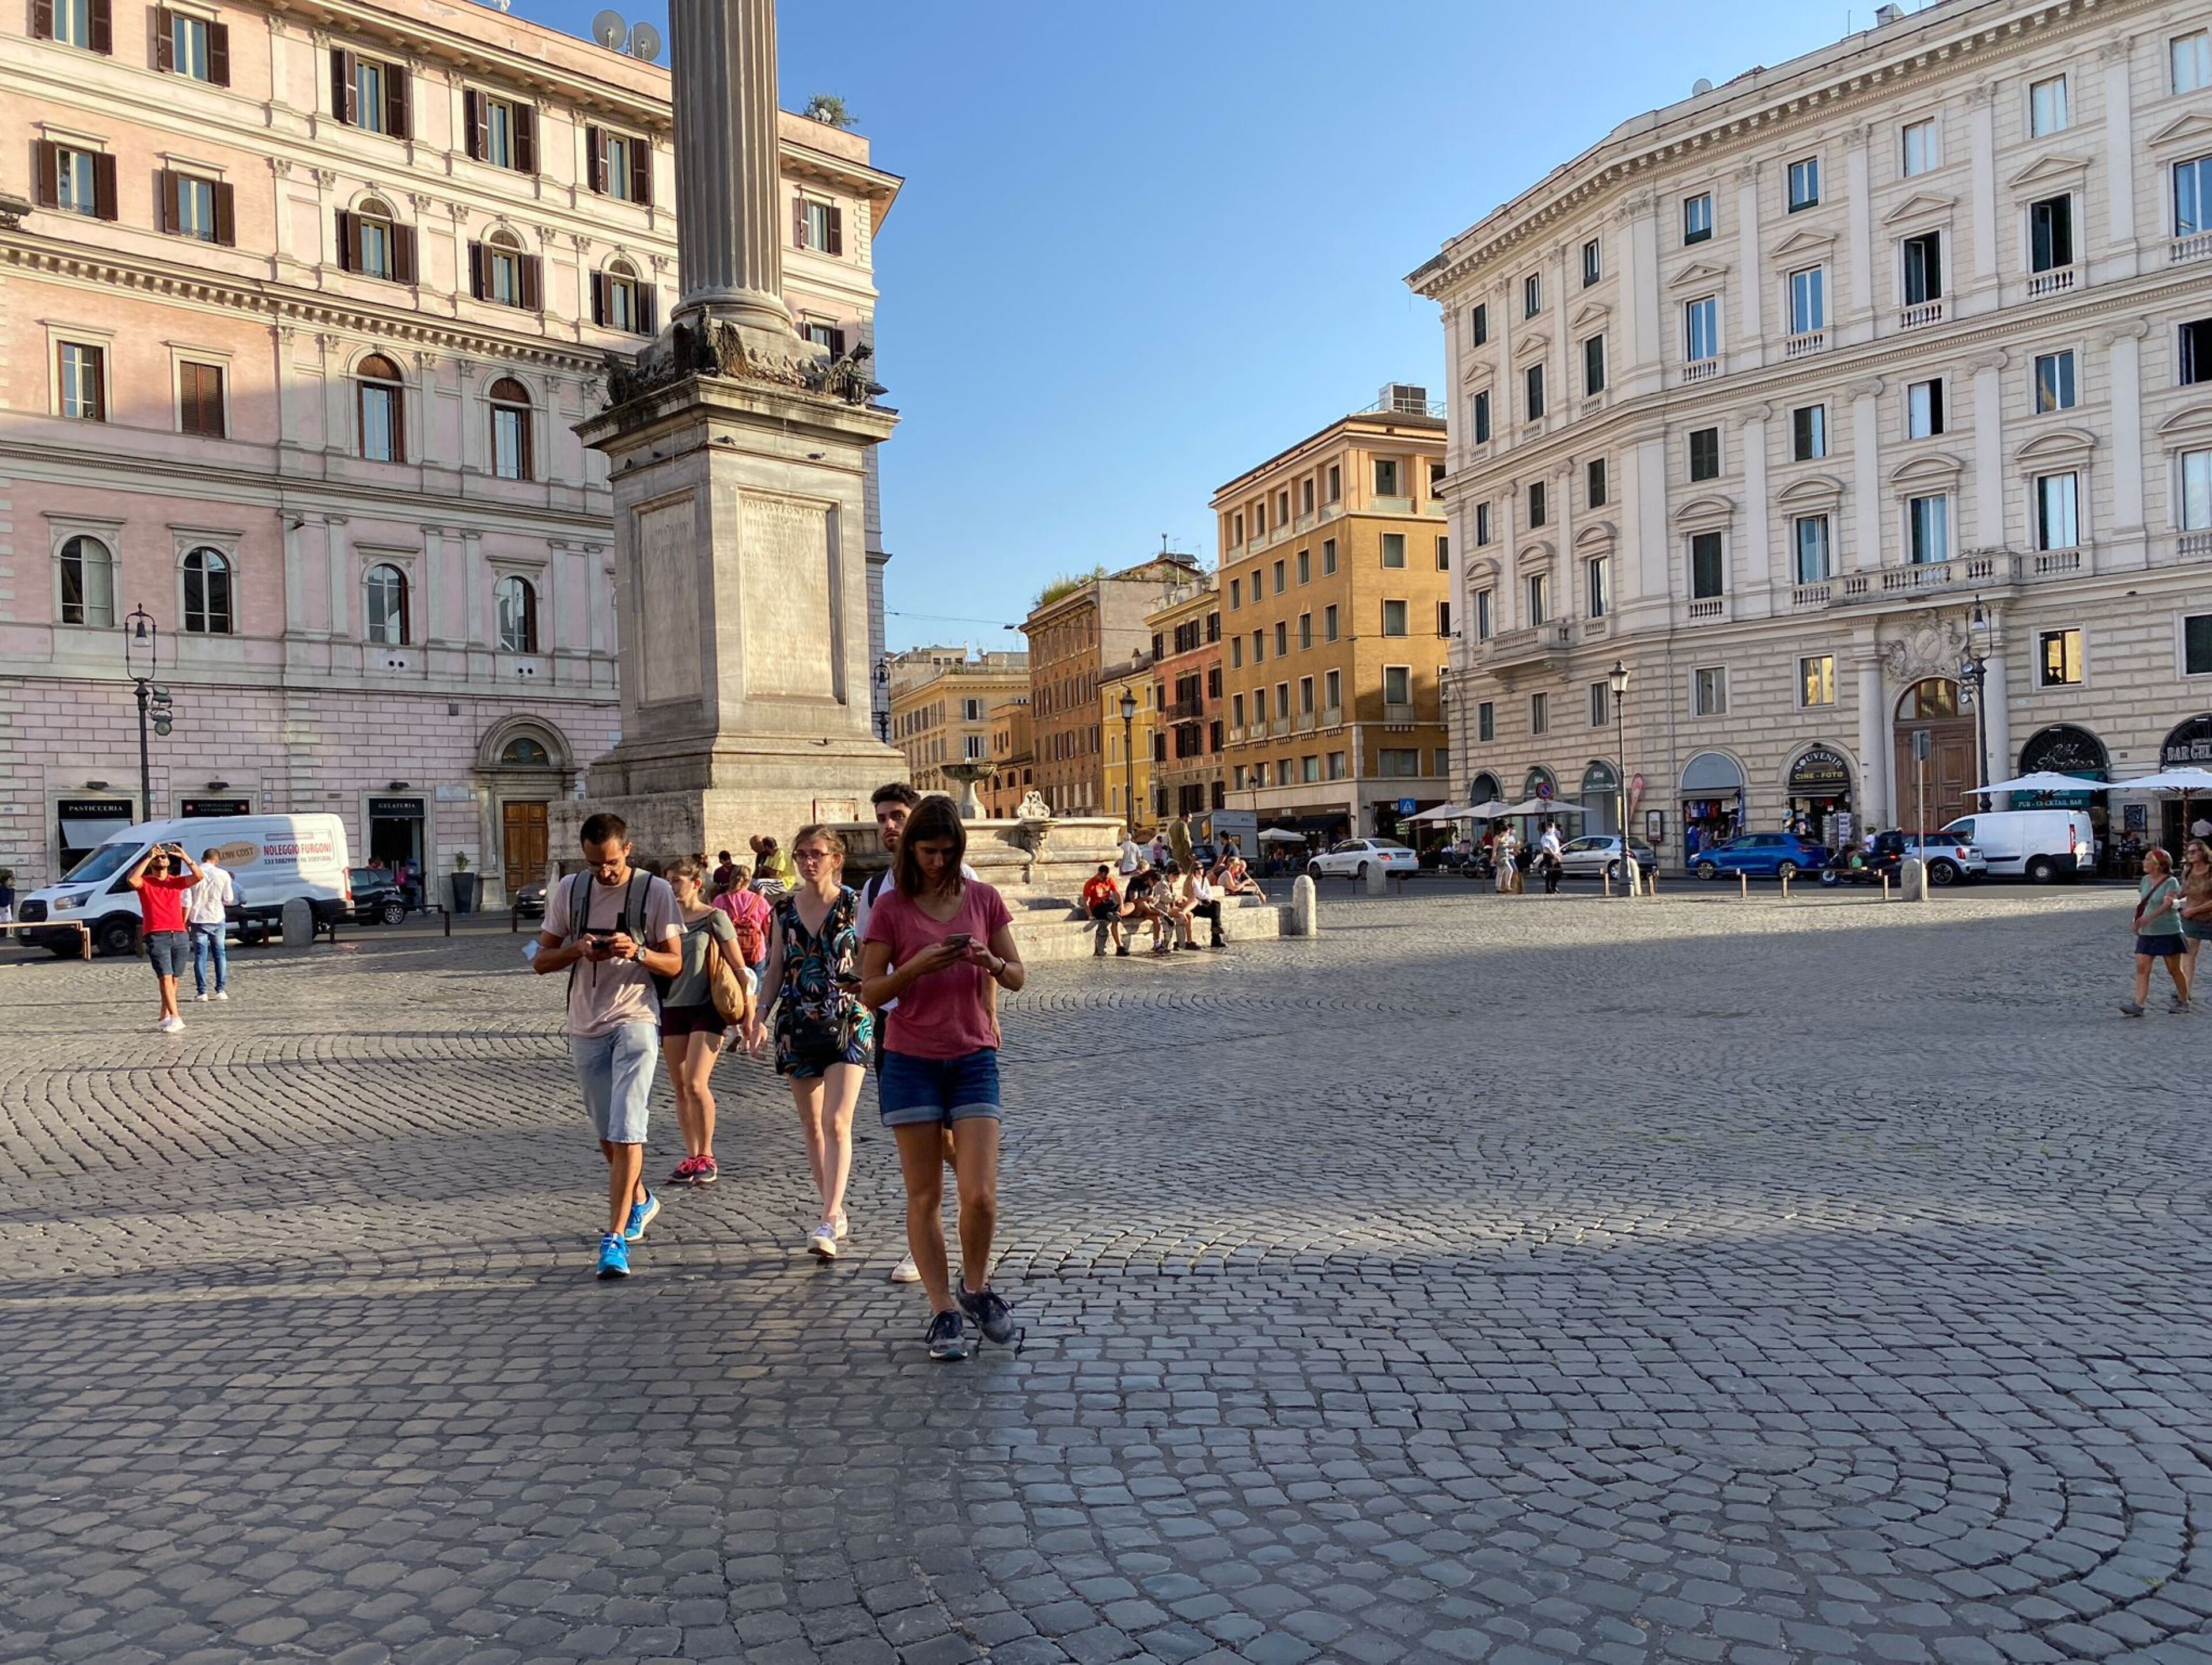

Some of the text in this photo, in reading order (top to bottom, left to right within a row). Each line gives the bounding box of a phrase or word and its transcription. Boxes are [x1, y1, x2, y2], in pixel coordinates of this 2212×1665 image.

[2166, 746, 2190, 761] BAR
[1794, 752, 1843, 772] SOUVENIR
[1821, 771, 1843, 779] FOTO
[236, 847, 253, 858] COST
[264, 843, 332, 856] NOLEGGIO FURGONI
